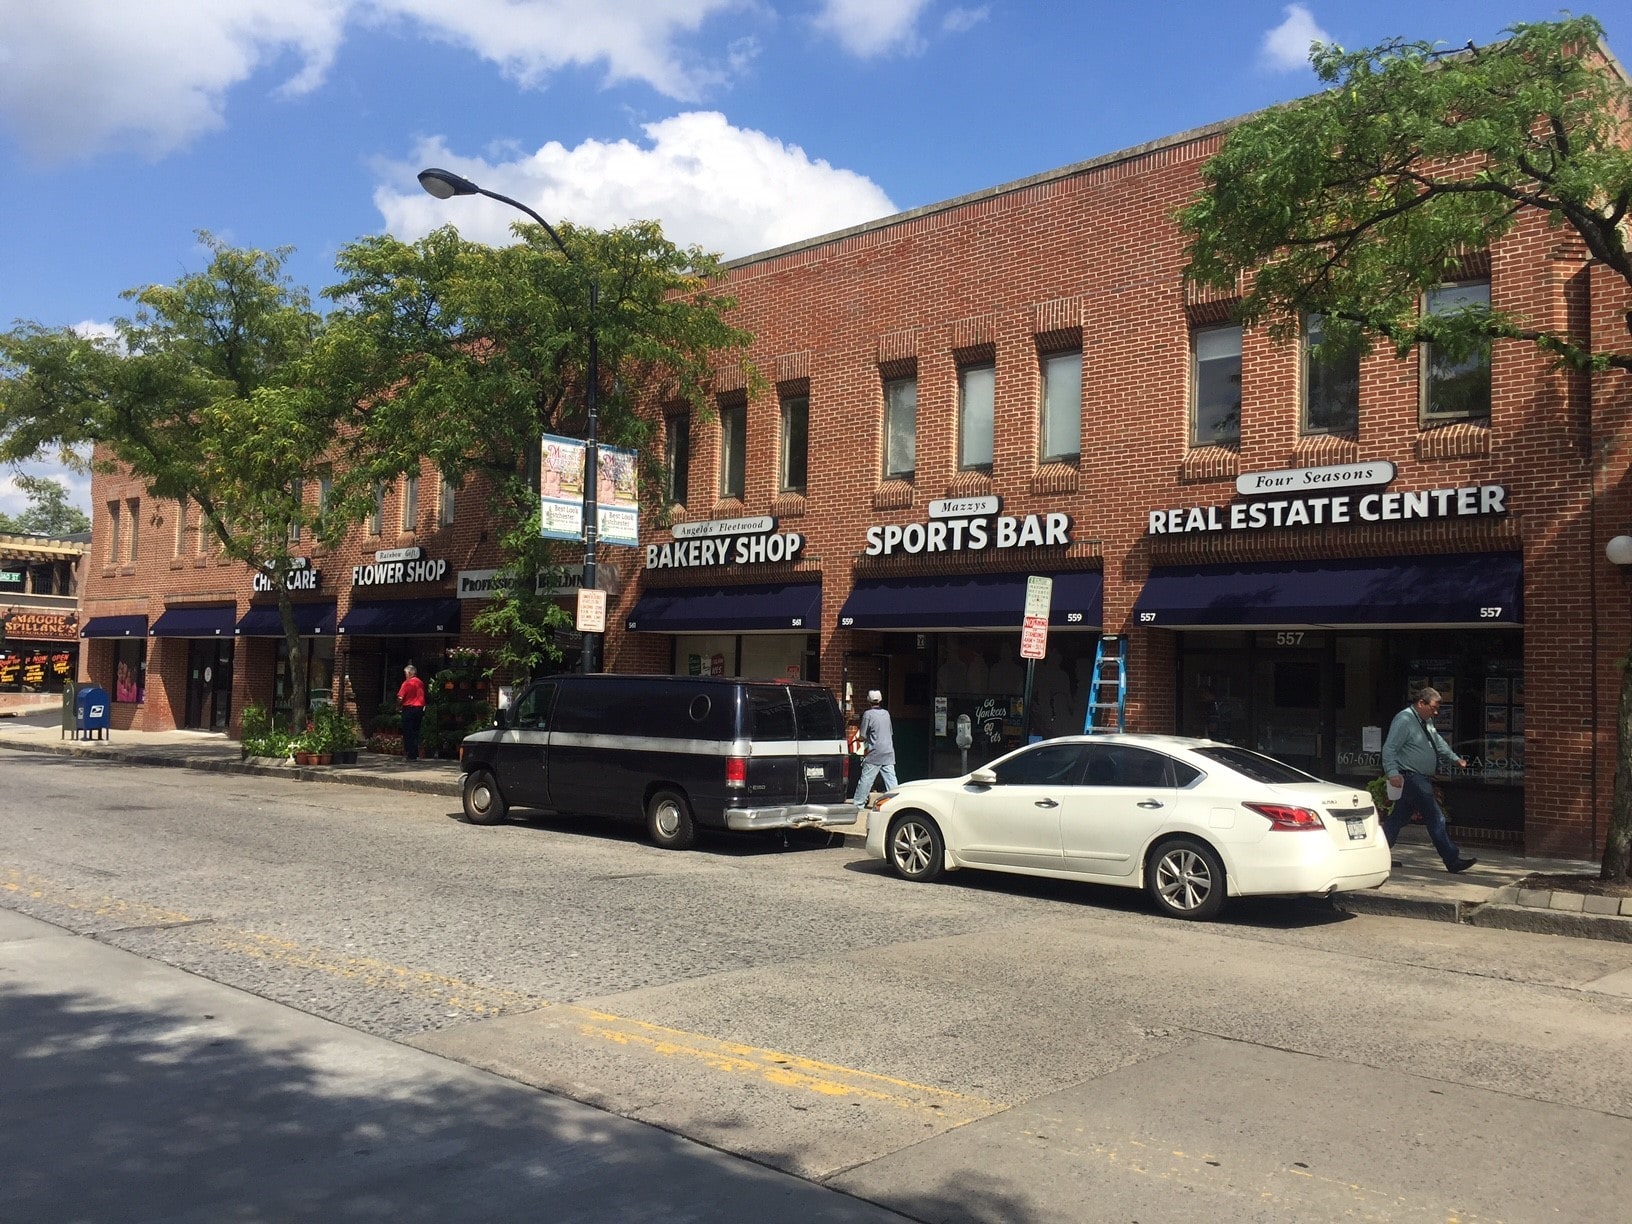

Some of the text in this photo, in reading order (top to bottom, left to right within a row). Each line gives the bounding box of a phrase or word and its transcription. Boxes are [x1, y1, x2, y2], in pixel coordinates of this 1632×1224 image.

[1255, 467, 1374, 489] Four Seasons
[941, 500, 987, 513] Mazzys
[1149, 485, 1506, 535] REAL ESTATE CENTER
[681, 519, 764, 537] Angelo's Fleetwood
[865, 512, 1070, 556] SPORTS BAR
[646, 533, 801, 569] BAKERY SHOP
[287, 569, 317, 590] CARE
[352, 559, 446, 586] FLOWER SHOP
[1067, 613, 1083, 622] 559
[1140, 612, 1156, 622] 557
[1480, 607, 1502, 618] 557
[5, 622, 78, 634] SPILLANE'S
[792, 618, 802, 627] 561
[842, 617, 853, 626] 559
[1276, 632, 1305, 646] 557
[1337, 752, 1381, 767] 667-6767
